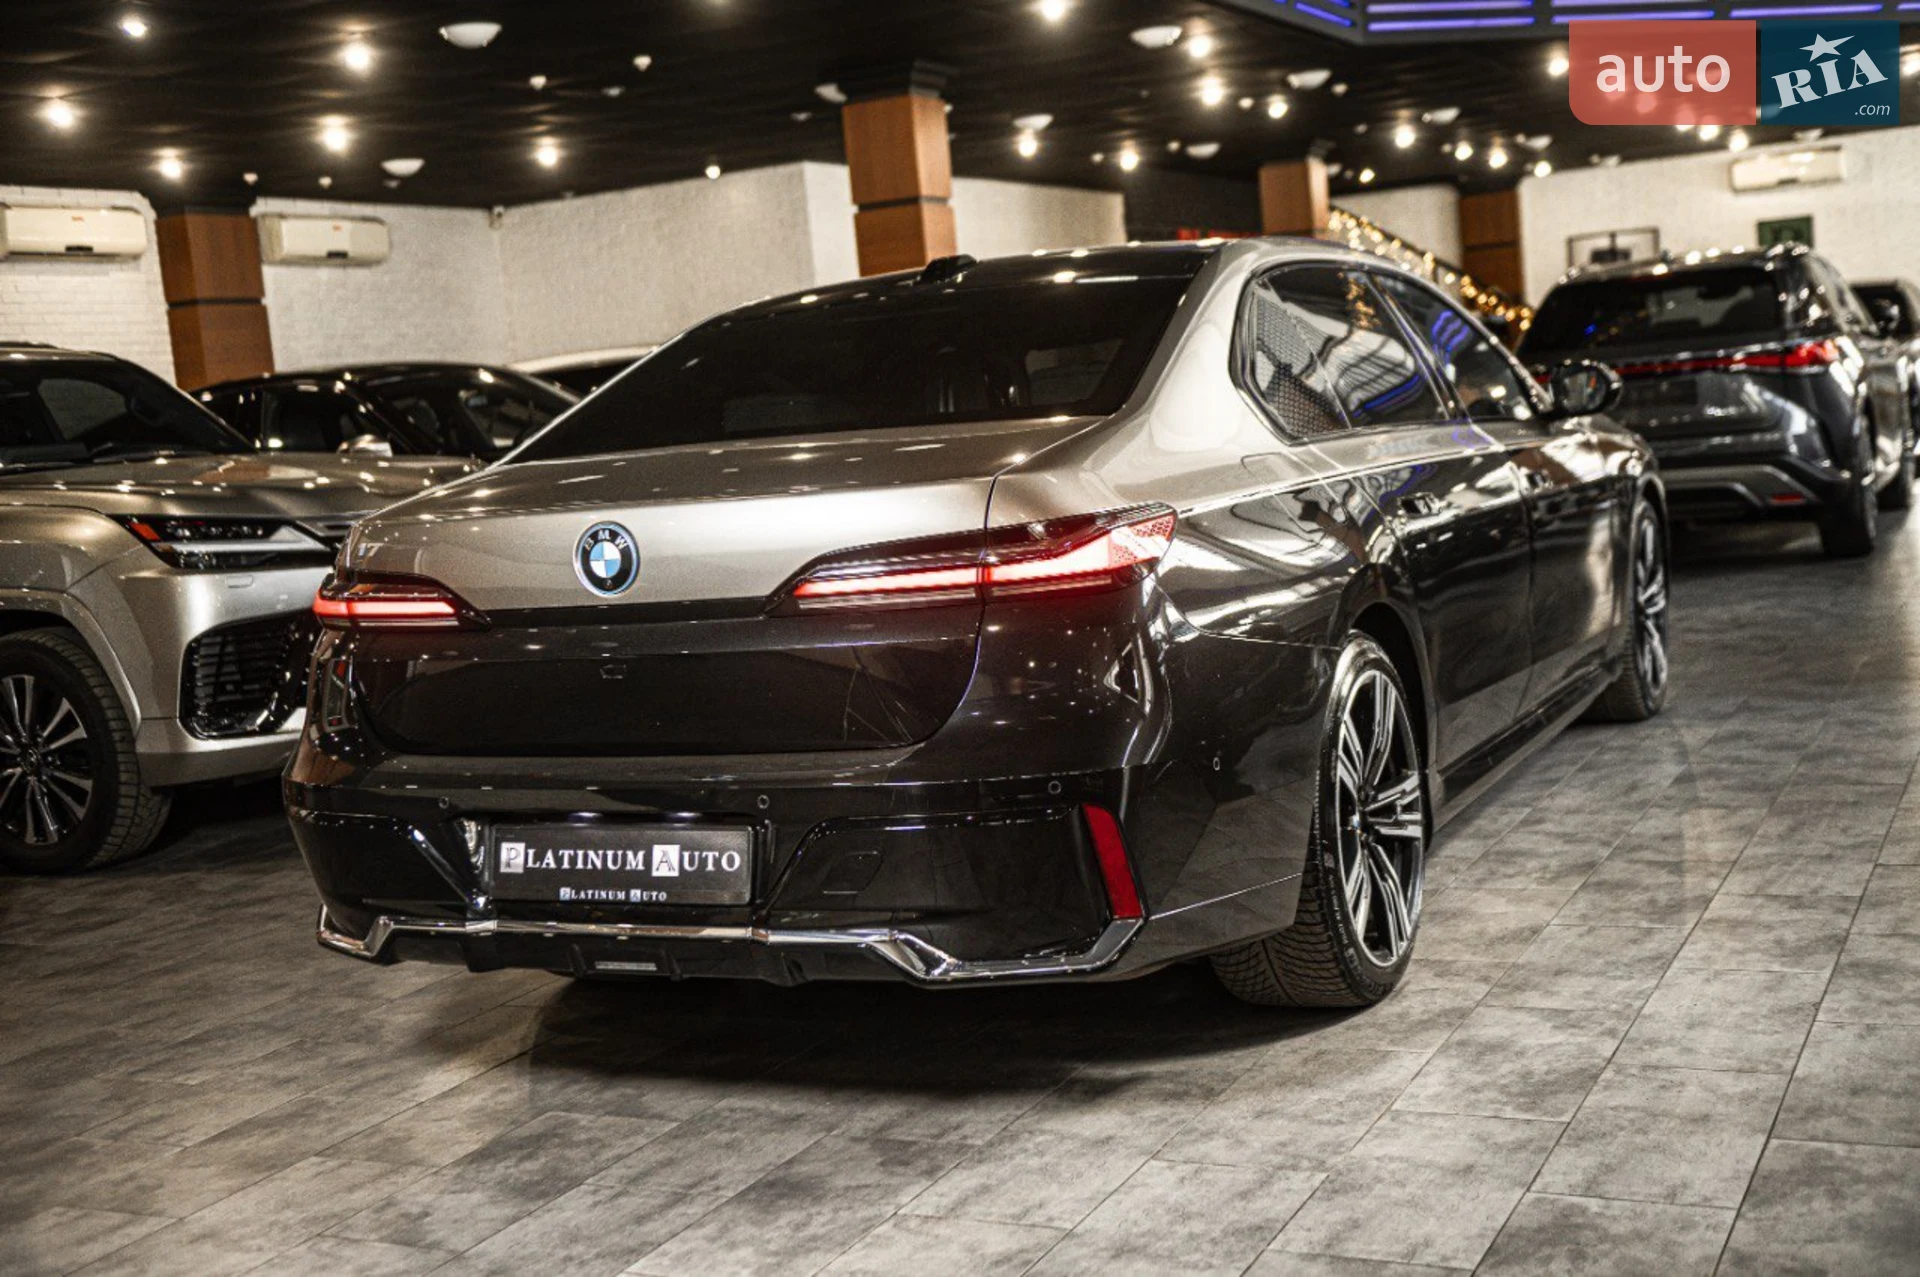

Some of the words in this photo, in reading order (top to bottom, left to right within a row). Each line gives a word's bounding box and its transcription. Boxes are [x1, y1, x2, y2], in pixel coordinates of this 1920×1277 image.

[585, 529, 629, 551] BMW
[500, 842, 646, 873] PLATINUM
[651, 844, 741, 877] AUTO
